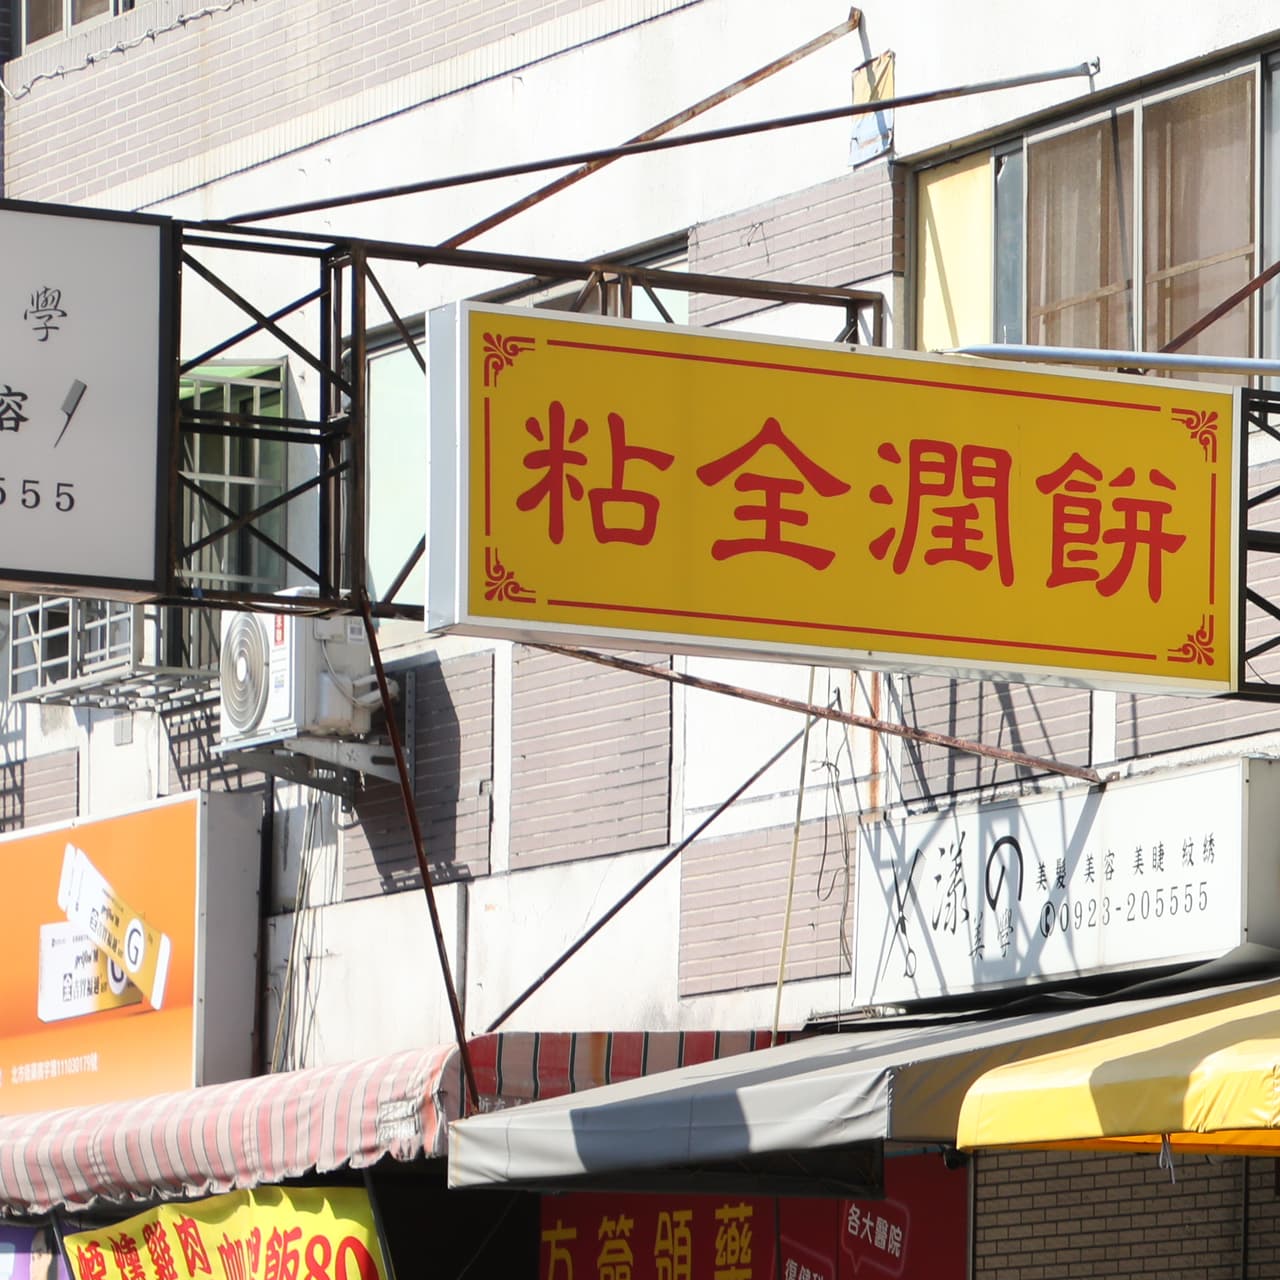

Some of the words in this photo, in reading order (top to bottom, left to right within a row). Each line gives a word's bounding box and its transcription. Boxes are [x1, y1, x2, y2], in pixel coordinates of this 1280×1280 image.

[24, 287, 67, 342] 學
[516, 400, 1187, 604] 粘全潤餅
[1083, 850, 1115, 884] 美容
[1131, 843, 1165, 875] 美睫
[1060, 881, 1209, 933] 0923-205555
[847, 1203, 902, 1259] 各大醫院
